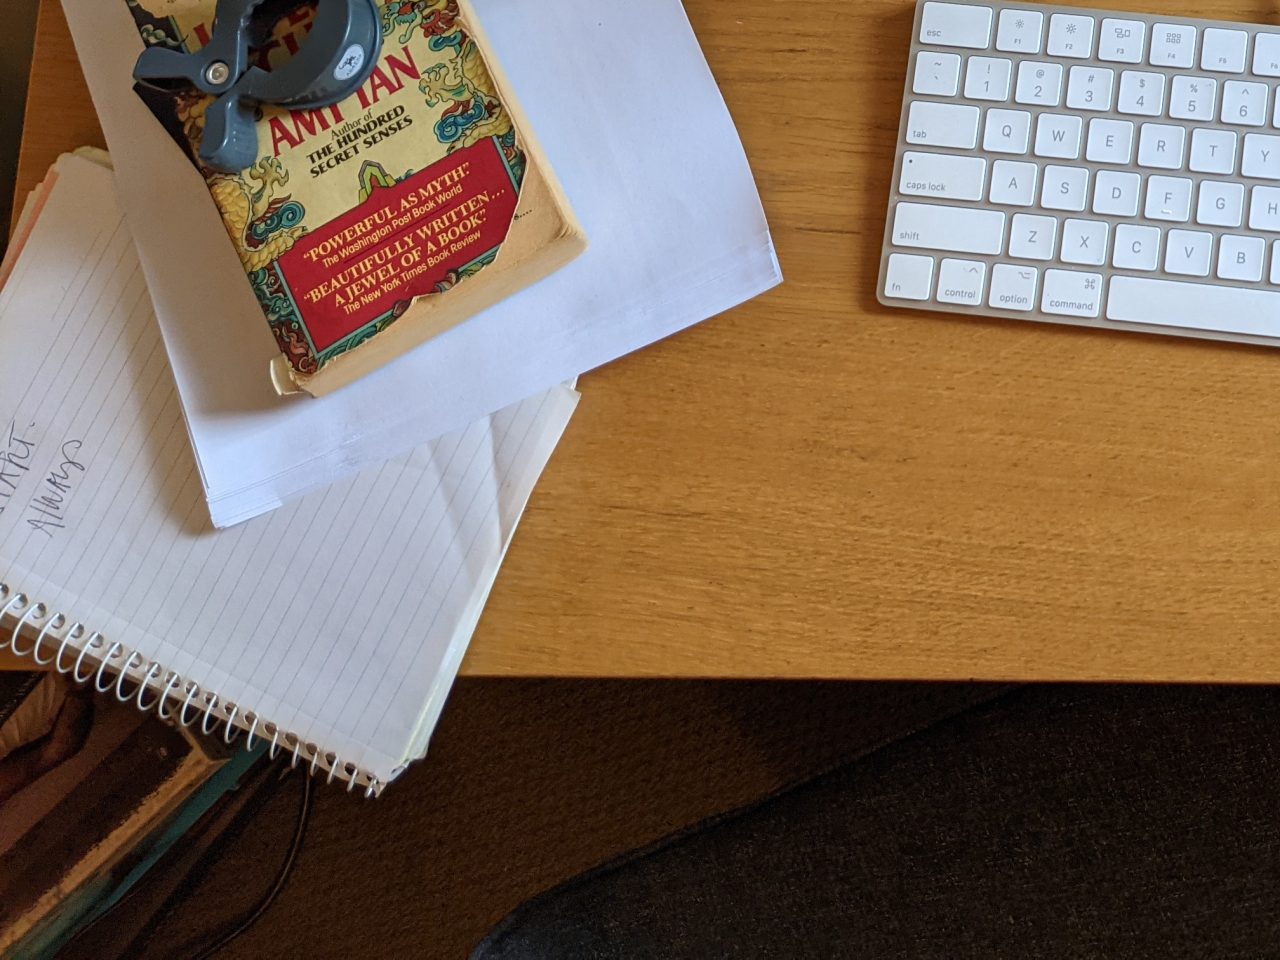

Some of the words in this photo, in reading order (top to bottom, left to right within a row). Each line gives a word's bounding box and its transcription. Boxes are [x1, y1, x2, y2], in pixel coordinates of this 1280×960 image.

[331, 117, 362, 141] Author
[363, 108, 374, 123] of
[306, 142, 336, 164] THE
[336, 105, 405, 149] HUNDRED
[913, 130, 927, 138] tab
[1002, 124, 1012, 139] Q
[1052, 129, 1065, 142] W
[310, 143, 361, 178] SECRET
[363, 115, 413, 149] SENSES
[1106, 135, 1114, 147] E
[1156, 140, 1166, 152] R
[1209, 145, 1218, 157] T
[1261, 150, 1270, 163] Y
[906, 181, 926, 192] caps
[928, 181, 946, 191] lock
[400, 192, 418, 212] AS
[322, 254, 340, 269] The
[339, 225, 392, 258] Washington
[391, 214, 413, 230] Post
[413, 199, 436, 218] Book
[435, 184, 463, 204] World
[899, 231, 919, 241] shift
[334, 292, 346, 307] A
[346, 266, 400, 302] JEWEL
[401, 246, 422, 267] OF
[427, 241, 438, 256] A
[343, 300, 361, 315] The
[361, 287, 382, 305] New
[380, 277, 402, 296] York
[400, 262, 427, 282] Times
[427, 249, 451, 267] Book
[450, 230, 482, 253] Review
[892, 282, 901, 291] fn
[944, 287, 976, 299] control
[998, 293, 1028, 307] option
[1049, 298, 1094, 311] command
